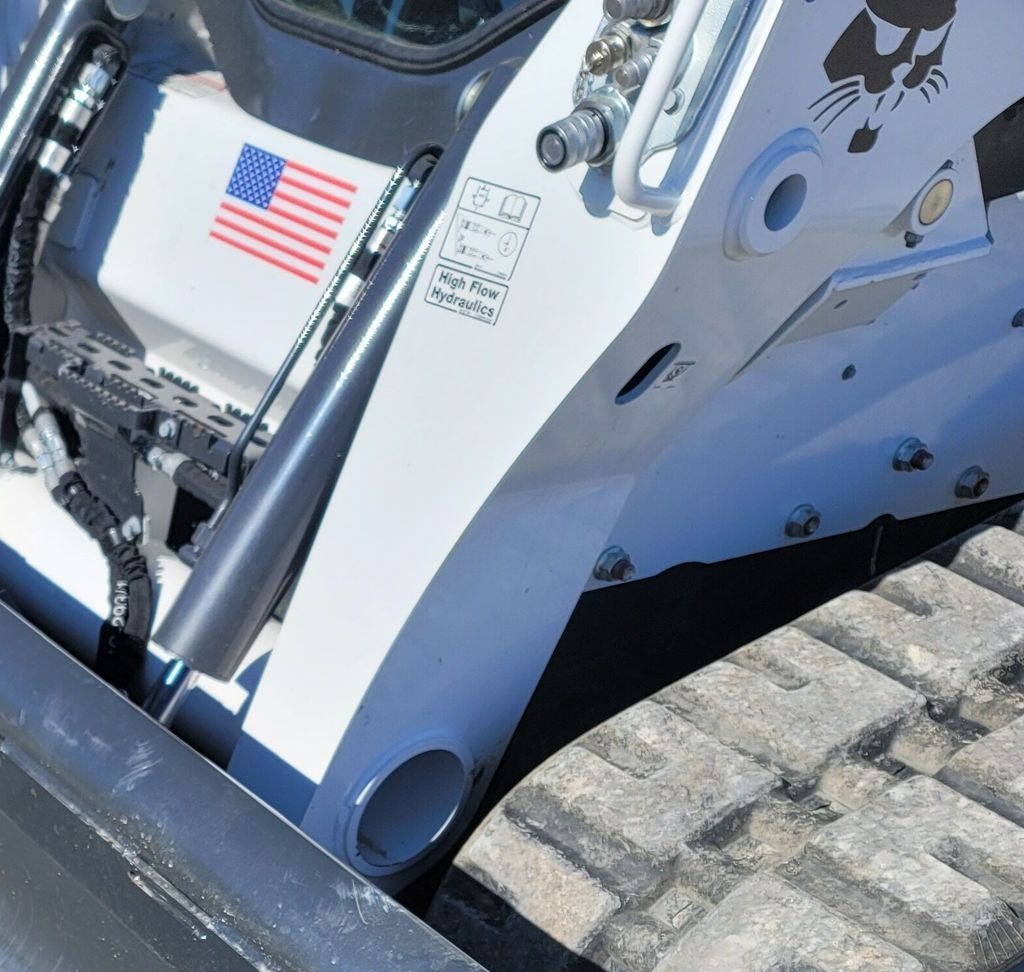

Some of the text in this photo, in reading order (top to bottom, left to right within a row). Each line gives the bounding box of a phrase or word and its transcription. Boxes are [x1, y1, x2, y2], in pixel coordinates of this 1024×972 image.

[438, 270, 466, 290] High
[469, 280, 500, 300] Flow
[430, 286, 495, 318] Hydraulics
